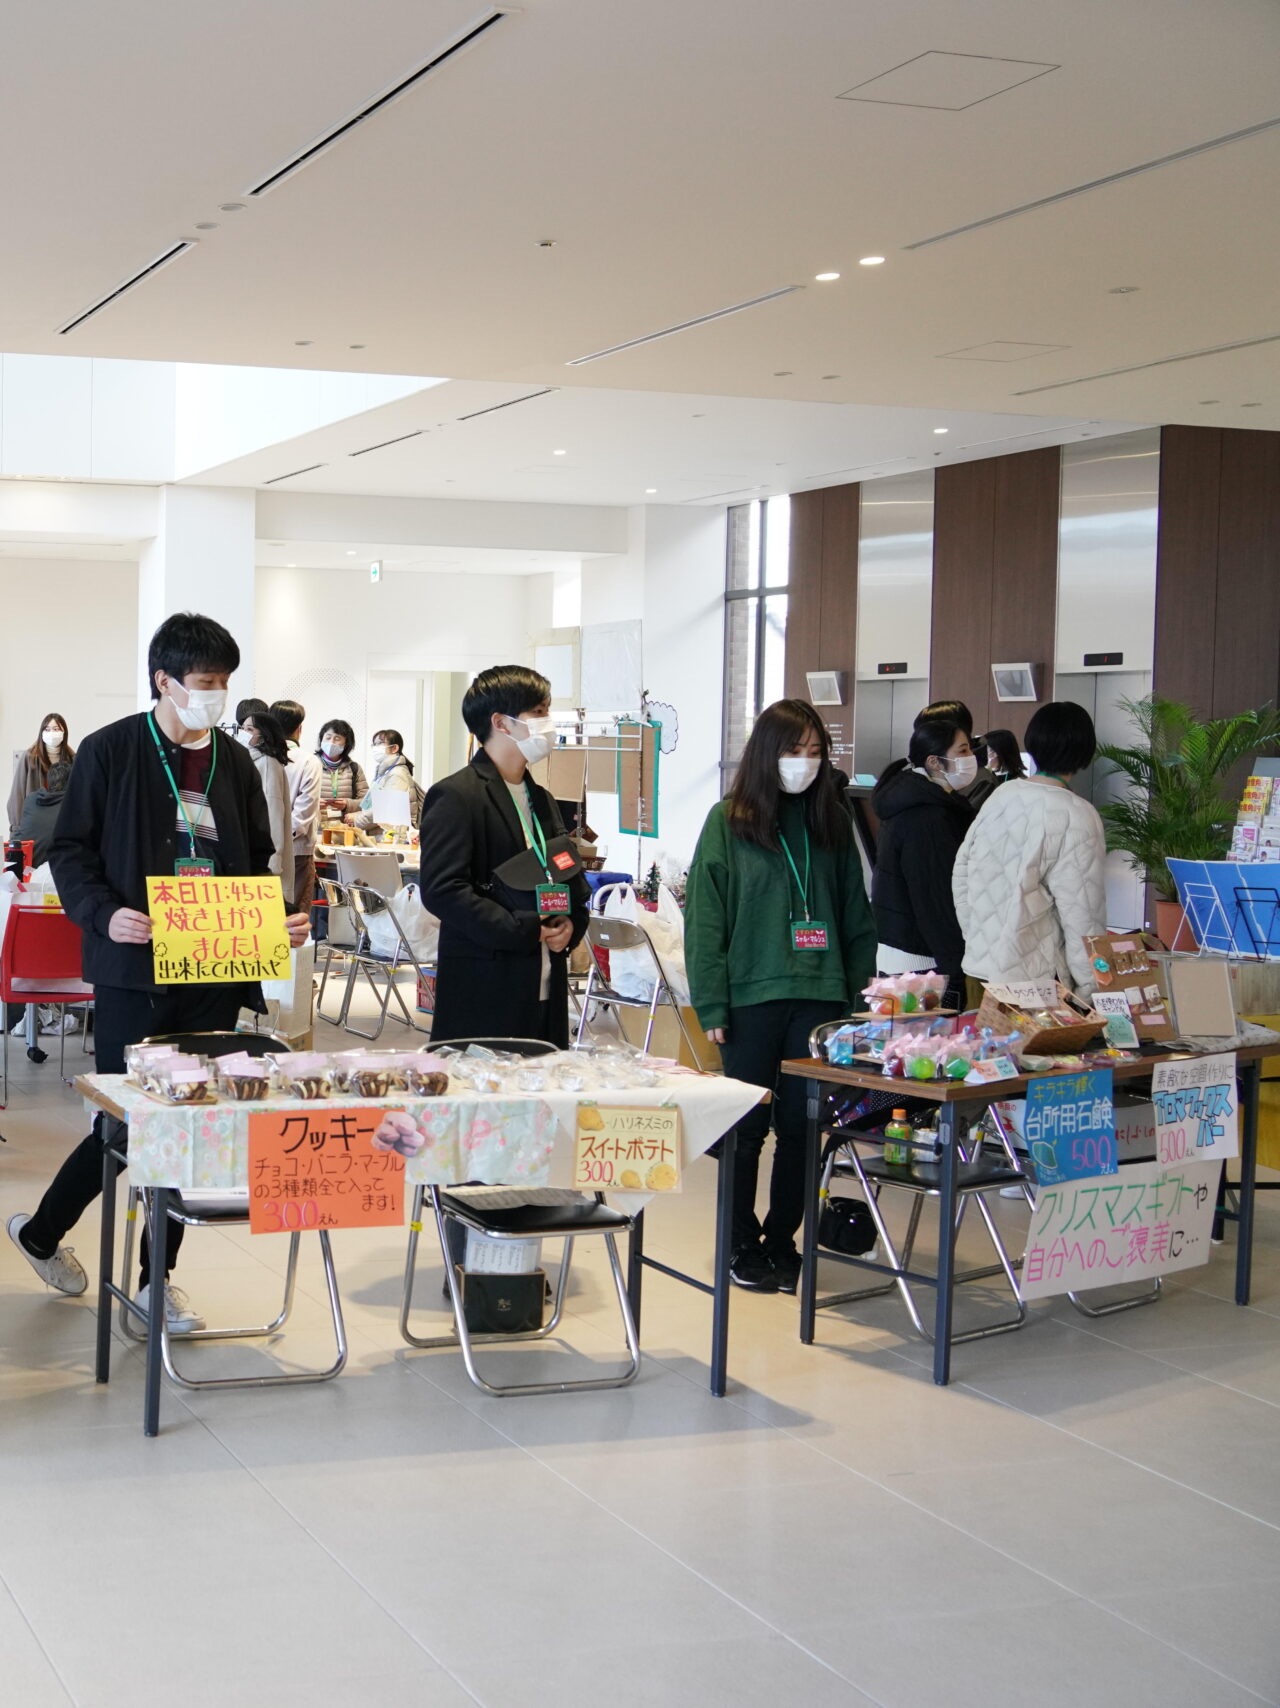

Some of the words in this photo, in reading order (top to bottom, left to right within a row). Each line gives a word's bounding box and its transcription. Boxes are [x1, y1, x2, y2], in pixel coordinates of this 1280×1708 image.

[153, 881, 276, 904] 本日11:45に
[165, 906, 262, 932] 焼き上がり
[192, 934, 260, 961] ました!
[159, 957, 281, 981] 出来たてホヤホヤ
[1026, 1095, 1114, 1140] 台所用石鹸
[1152, 1084, 1233, 1126] アロマワックス
[279, 1114, 375, 1154] クッキー
[612, 1116, 673, 1130] ハリネズミの
[1196, 1116, 1225, 1147] バー
[580, 1136, 674, 1162] スイートポテト
[254, 1177, 385, 1199] の3種類全て入って
[1037, 1172, 1208, 1235] クリスマスギフトや
